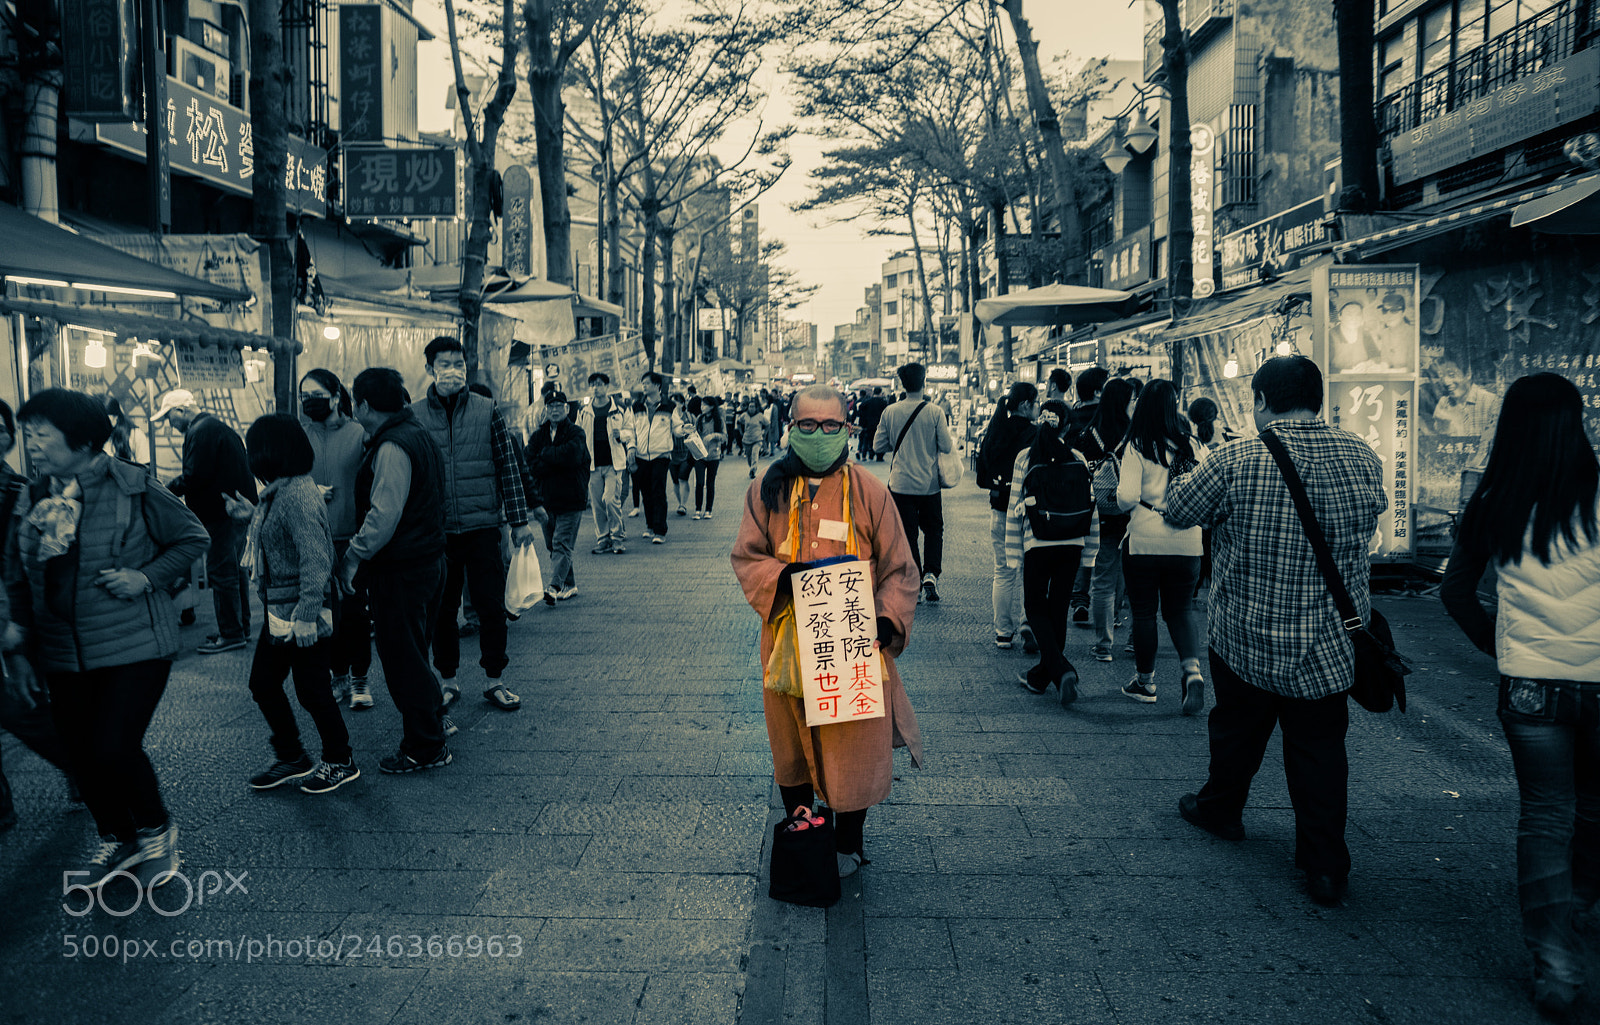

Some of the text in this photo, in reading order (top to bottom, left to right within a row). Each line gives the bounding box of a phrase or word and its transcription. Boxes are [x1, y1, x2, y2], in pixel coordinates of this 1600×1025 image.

[89, 0, 116, 100] 俗小吃
[360, 152, 443, 193] 現炒
[800, 569, 842, 718] 統一發票也可
[838, 568, 878, 717] 安養院基金
